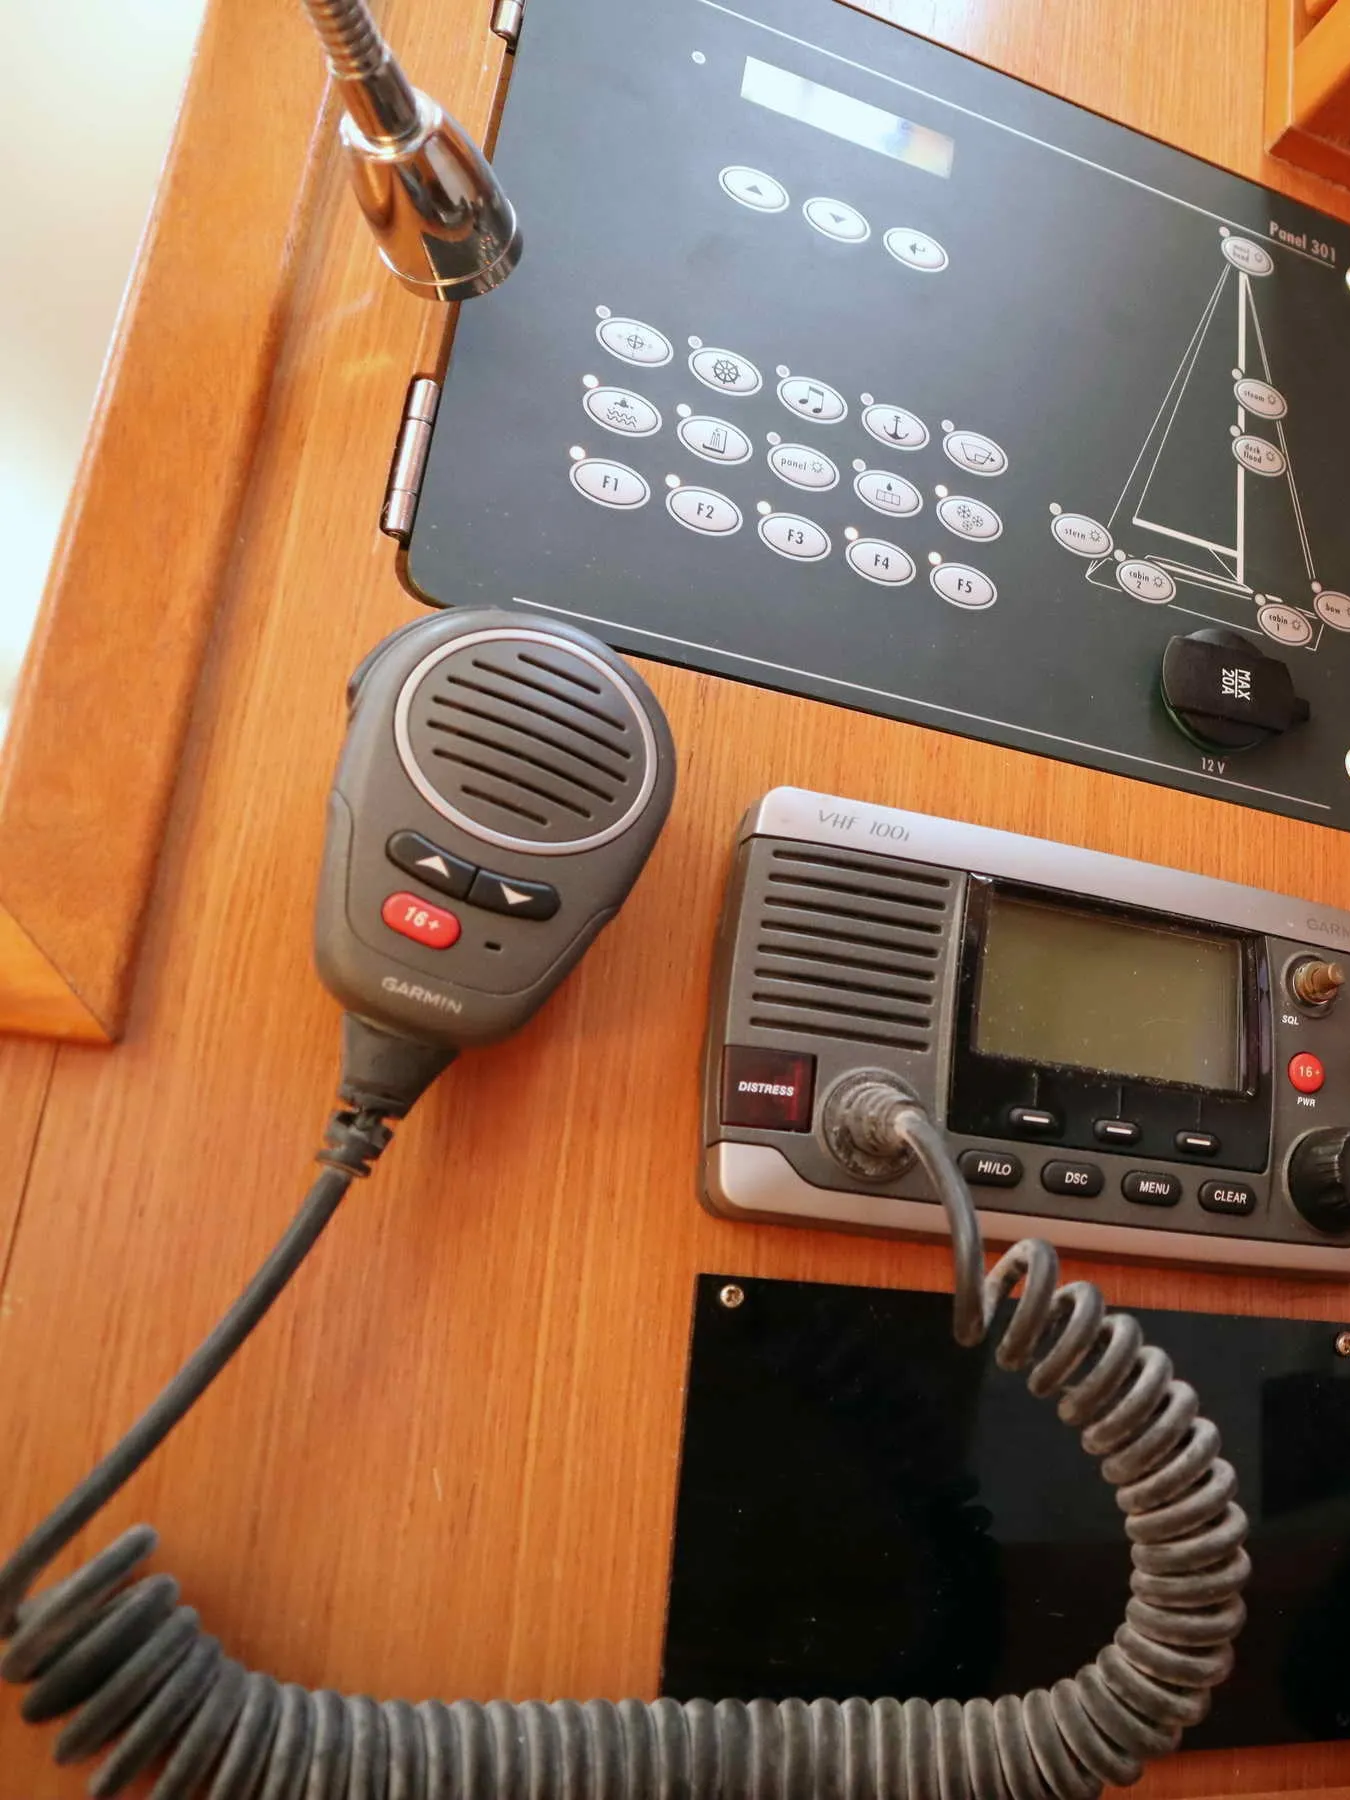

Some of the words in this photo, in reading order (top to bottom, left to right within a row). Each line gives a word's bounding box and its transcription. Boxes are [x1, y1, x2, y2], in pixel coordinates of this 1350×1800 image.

[1269, 220, 1307, 249] Panel
[1311, 239, 1336, 263] 301
[780, 457, 808, 471] panel
[601, 475, 621, 492] F1
[696, 503, 715, 520] F2
[786, 529, 805, 546] F3
[1064, 527, 1087, 541] stern
[873, 553, 891, 571] F4
[956, 578, 973, 594] F5
[1221, 667, 1236, 695] 20A
[1238, 668, 1252, 701] MAX
[1201, 757, 1215, 773] 12
[817, 808, 861, 832] VHF
[868, 819, 911, 843] 100i
[380, 975, 463, 1014] GARMIN
[1280, 1013, 1300, 1026] SQL
[737, 1080, 795, 1098] DISTRESS
[1296, 1095, 1316, 1108] PWR
[977, 1160, 1013, 1177] HI/LO
[1064, 1171, 1089, 1186] DSC
[1138, 1180, 1171, 1197] MENU
[1213, 1188, 1248, 1205] CLEAR
